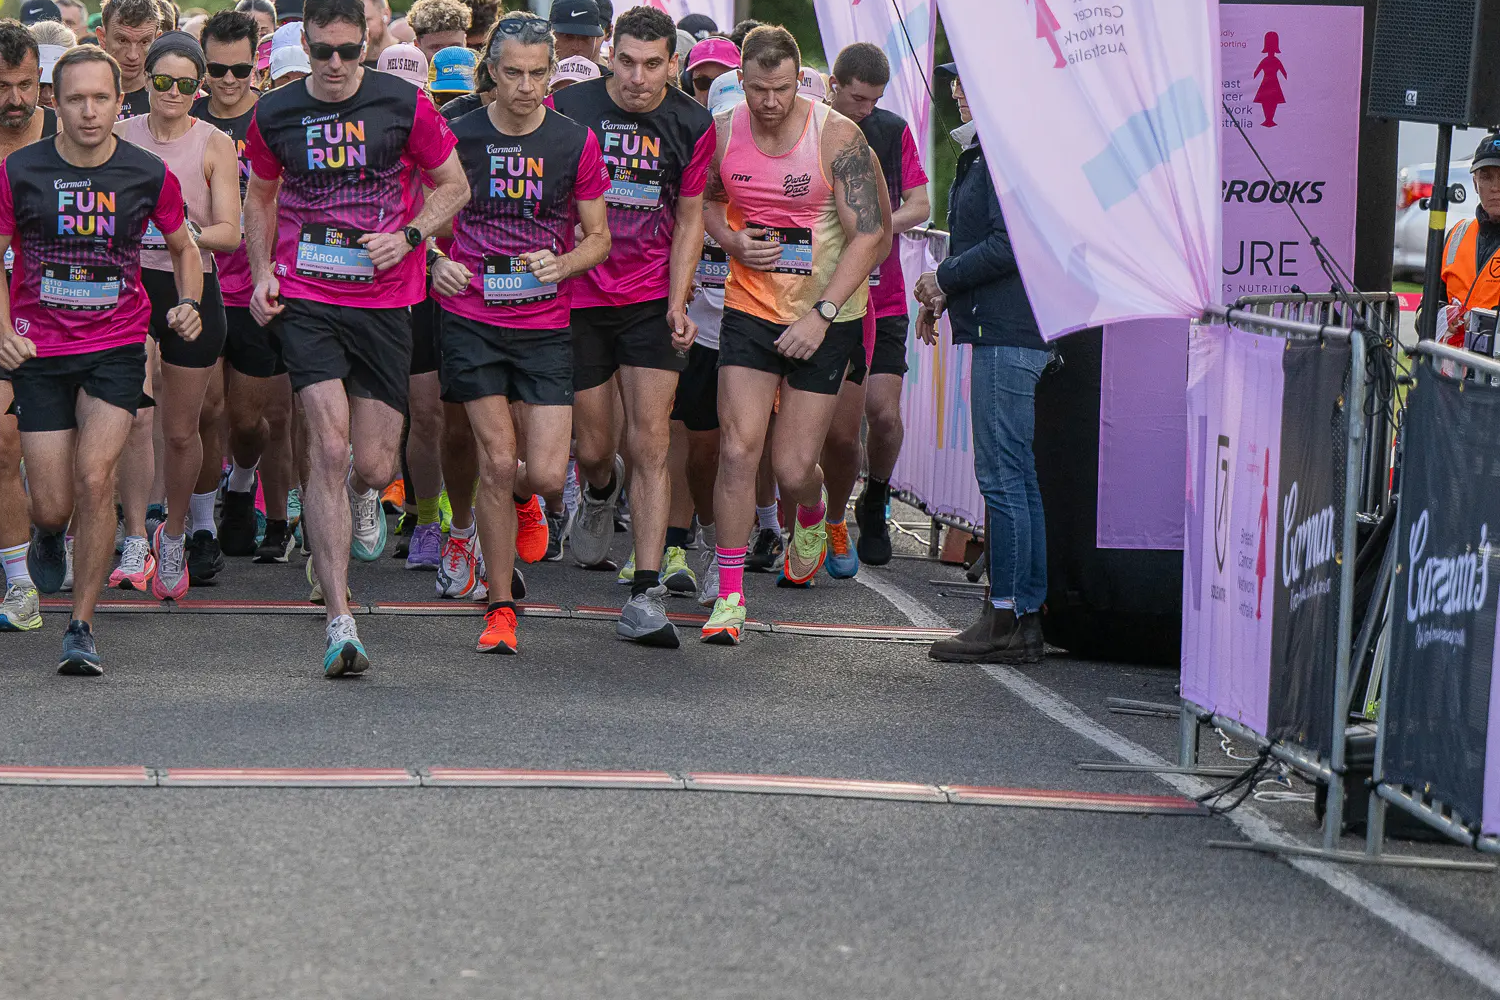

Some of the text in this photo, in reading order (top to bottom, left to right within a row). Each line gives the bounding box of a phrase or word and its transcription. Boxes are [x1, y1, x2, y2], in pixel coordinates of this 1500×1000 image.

[1222, 105, 1253, 115] work
[601, 119, 639, 131] Carman's
[1221, 118, 1253, 128] stralia
[305, 120, 365, 147] FUN
[486, 143, 522, 155] Carman's
[603, 131, 661, 158] FUN
[307, 144, 367, 170] RUN
[490, 155, 544, 178] FUN
[53, 178, 92, 190] Carman's
[489, 177, 543, 200] RUN
[783, 183, 810, 198] Pace
[604, 187, 634, 197] NTON
[58, 191, 116, 213] FUN
[57, 215, 115, 236] RUN
[300, 250, 346, 265] FEARGAL
[1222, 240, 1299, 277] URE
[705, 263, 728, 275] 593
[487, 277, 522, 289] 6000
[1238, 284, 1290, 293] NUTRITIO
[44, 285, 91, 297] STEPHEN
[1283, 481, 1335, 588] Carman
